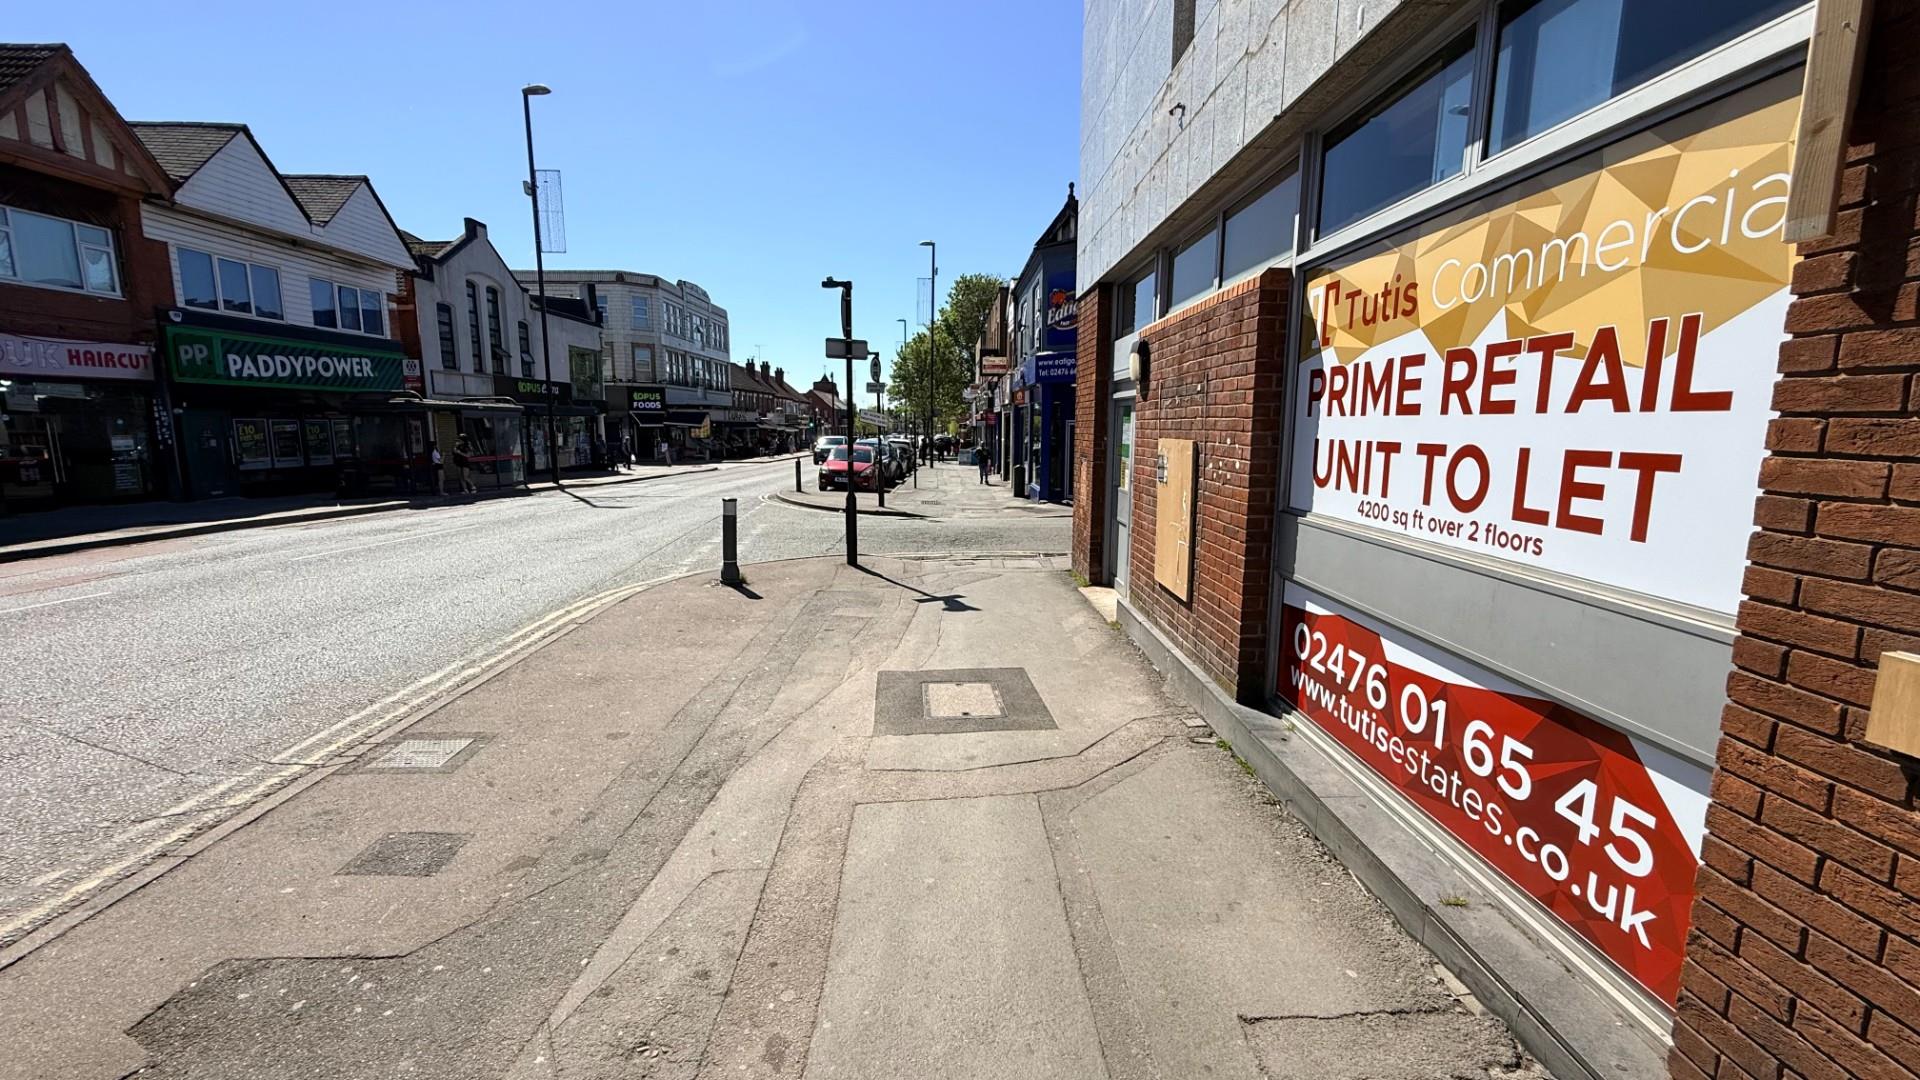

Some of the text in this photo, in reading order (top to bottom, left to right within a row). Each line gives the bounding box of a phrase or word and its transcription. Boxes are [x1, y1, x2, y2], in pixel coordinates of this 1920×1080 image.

[1344, 274, 1418, 330] Tutis
[67, 348, 150, 370] HAIRCUT
[1307, 313, 1734, 417] PRIME RETAIL
[633, 401, 662, 409] FOODS
[1313, 437, 1683, 544] UNIT TO LET
[1357, 500, 1544, 557] 4200 sq ft over 2 floors
[1294, 622, 1657, 878] 02476 01 65 45
[1290, 664, 1658, 951] www.tutisestates.co.uk
